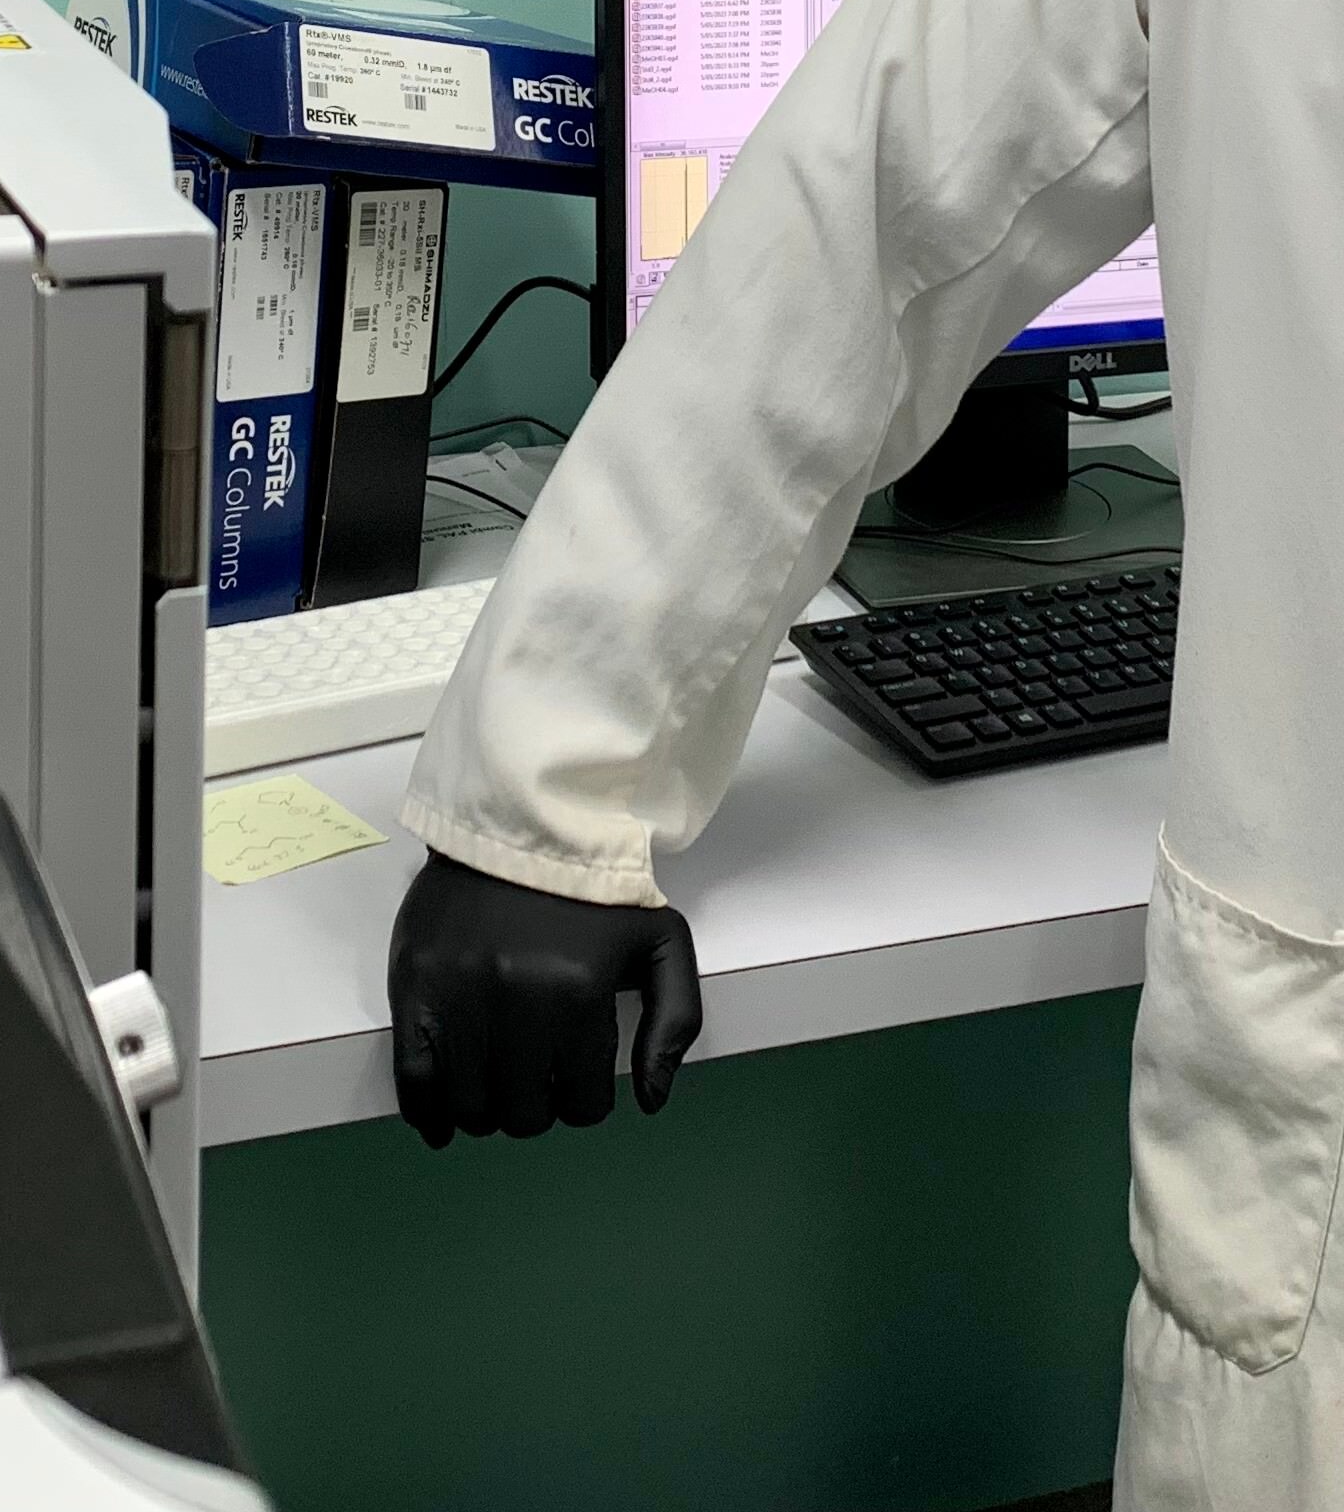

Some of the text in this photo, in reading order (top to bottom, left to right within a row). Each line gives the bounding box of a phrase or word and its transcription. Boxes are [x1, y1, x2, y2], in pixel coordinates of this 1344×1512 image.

[512, 76, 594, 108] RESTEK
[306, 106, 358, 127] RESTEK
[514, 115, 553, 143] GC
[232, 194, 248, 241] RESTEK
[421, 249, 434, 322] SHIMADZU
[1068, 352, 1116, 372] DELL
[263, 414, 294, 511] RESTEK
[219, 416, 256, 590] GC Columns
